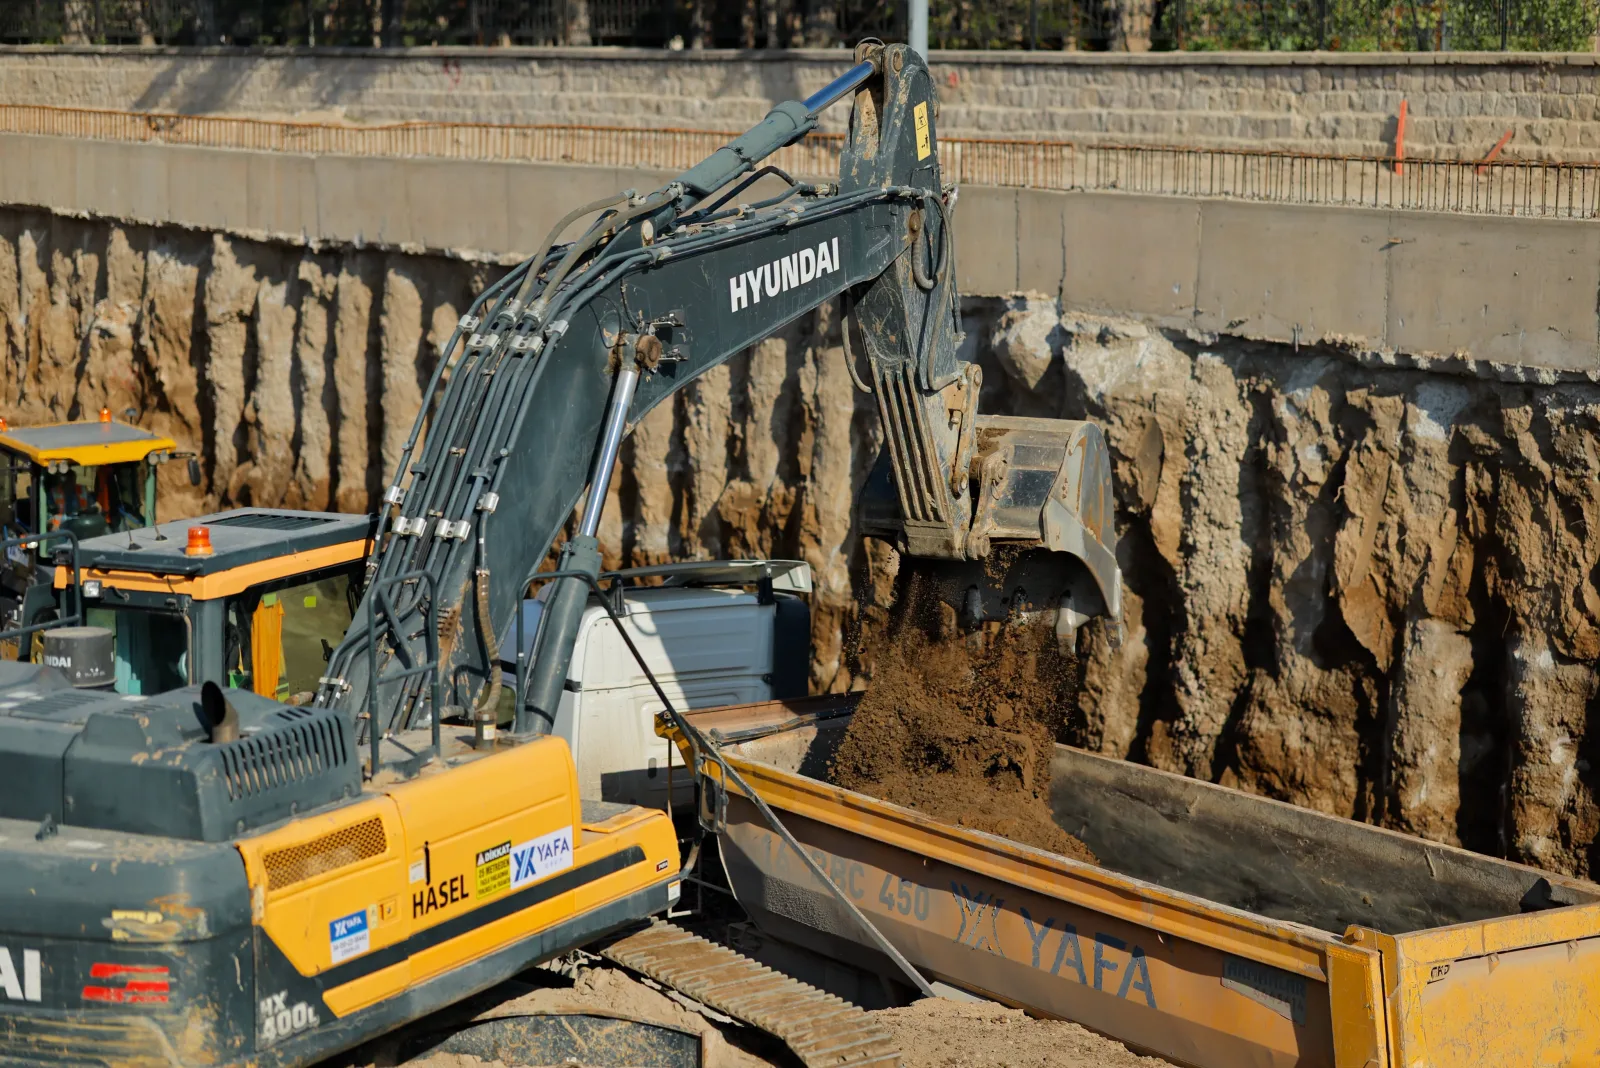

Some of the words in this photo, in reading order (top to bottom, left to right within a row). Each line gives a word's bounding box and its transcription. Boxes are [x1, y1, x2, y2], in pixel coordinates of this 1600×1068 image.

[729, 236, 840, 313] HYUNDAI
[537, 836, 570, 862] YAFA
[412, 874, 470, 919] HASEL
[879, 874, 930, 921] 450
[1020, 906, 1158, 1009] YAFA
[260, 989, 288, 1017] HX
[262, 1001, 320, 1041] 400L
